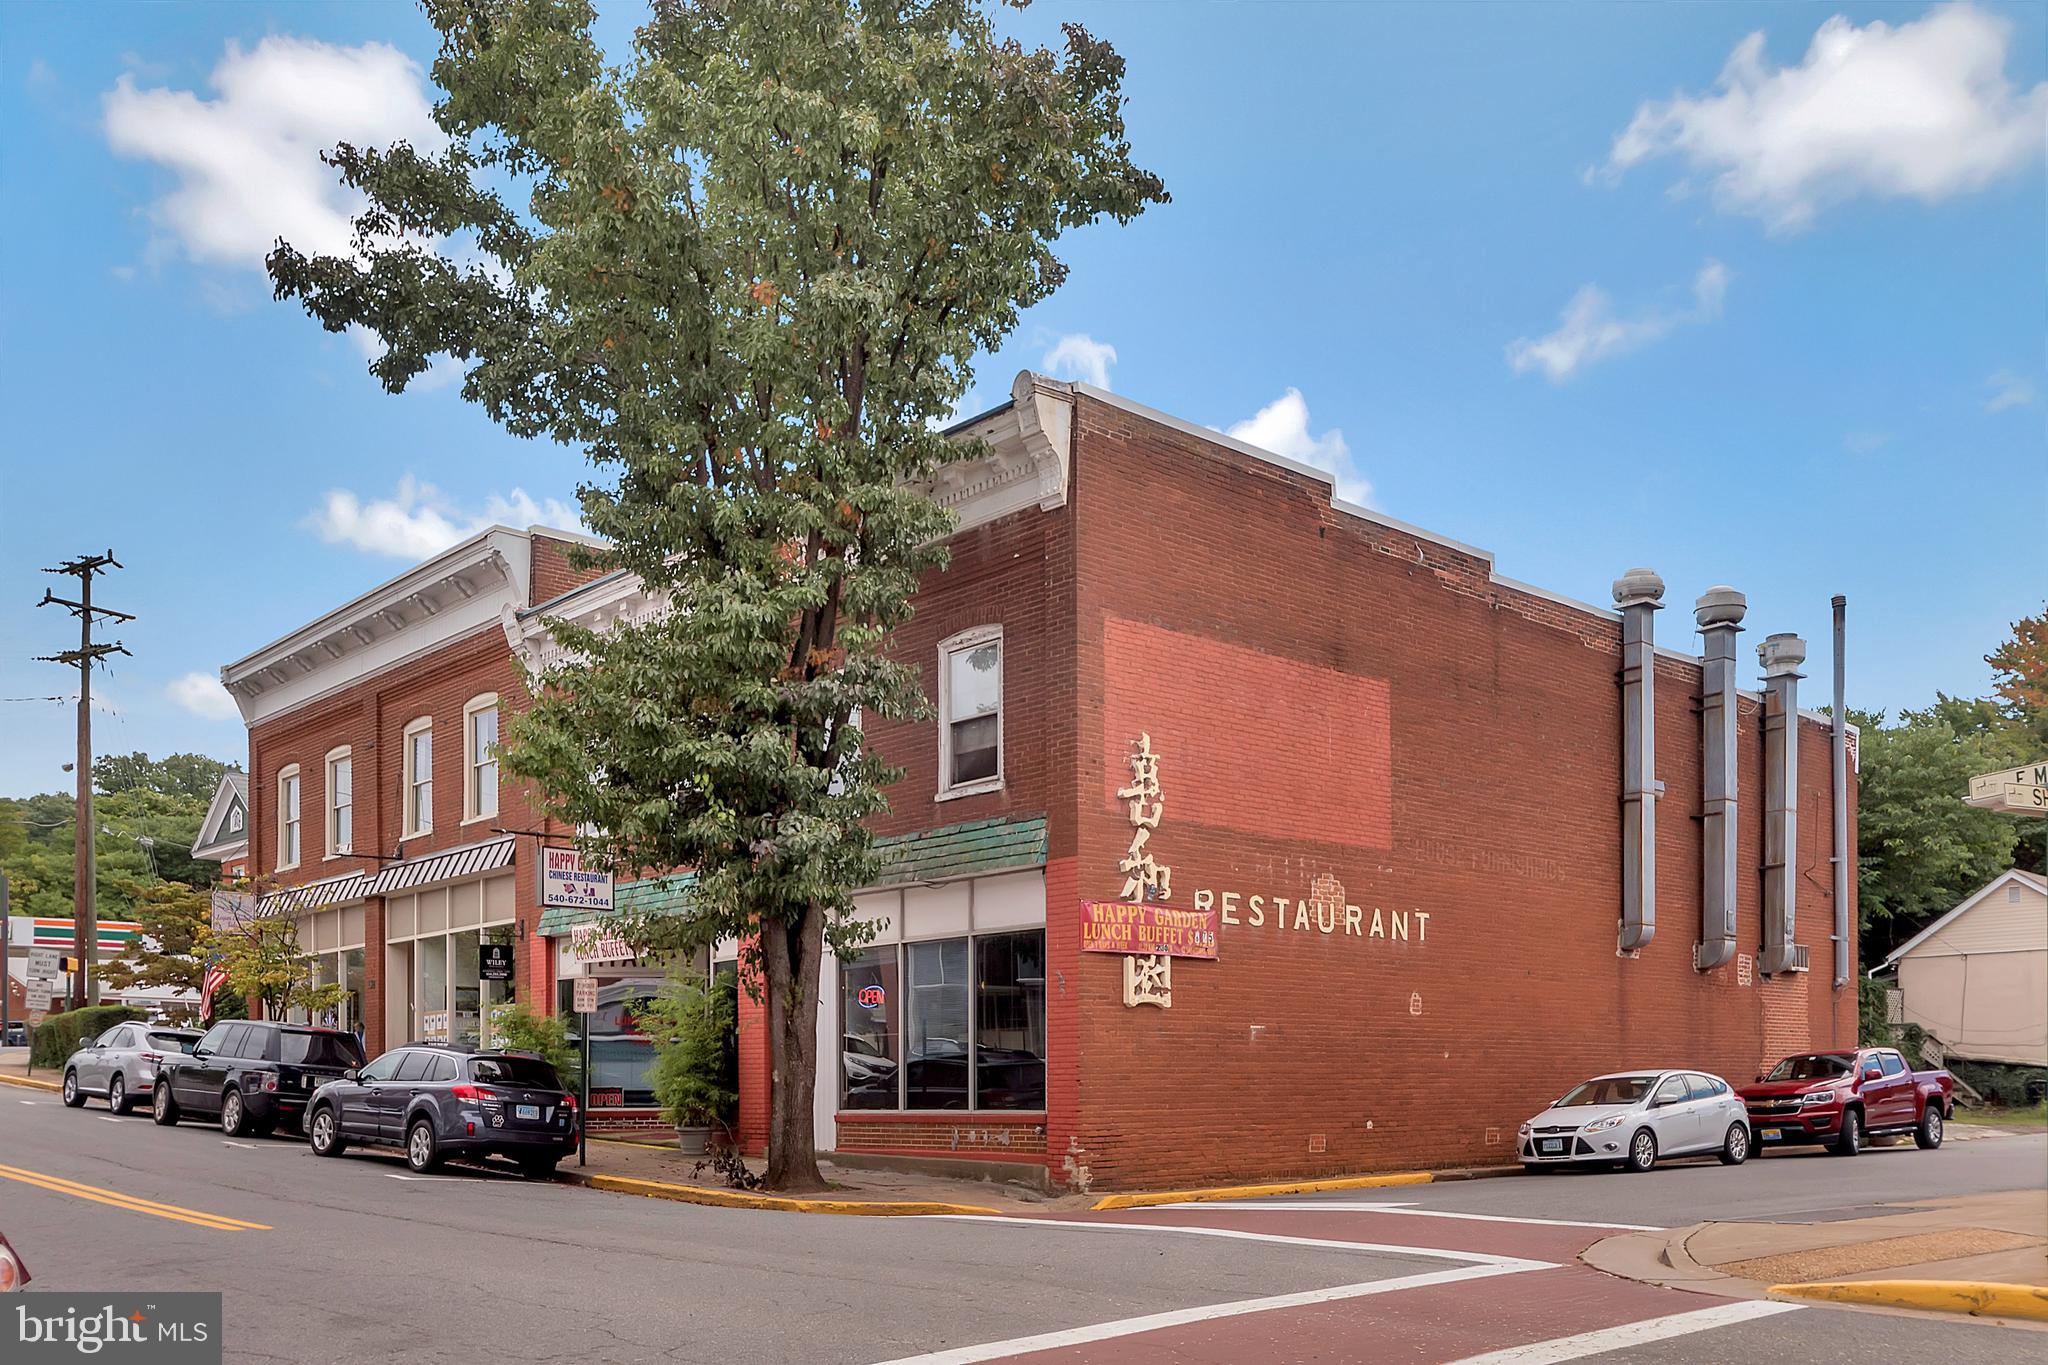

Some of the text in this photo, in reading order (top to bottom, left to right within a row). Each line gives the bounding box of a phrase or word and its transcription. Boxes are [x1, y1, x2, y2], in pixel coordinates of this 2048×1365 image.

[549, 851, 575, 871] HAPPY
[549, 870, 608, 884] CHINESE RESTAURANT
[548, 894, 609, 906] 540-672-1044
[1092, 903, 1208, 929] HAPPY GARDEN
[1193, 888, 1429, 942] RESTAURANT
[573, 927, 595, 943] HAPP
[1083, 922, 1132, 941] LUNCH
[1138, 925, 1184, 945] BUFFET
[858, 988, 885, 1005] OPEN
[591, 1093, 622, 1106] OPEN
